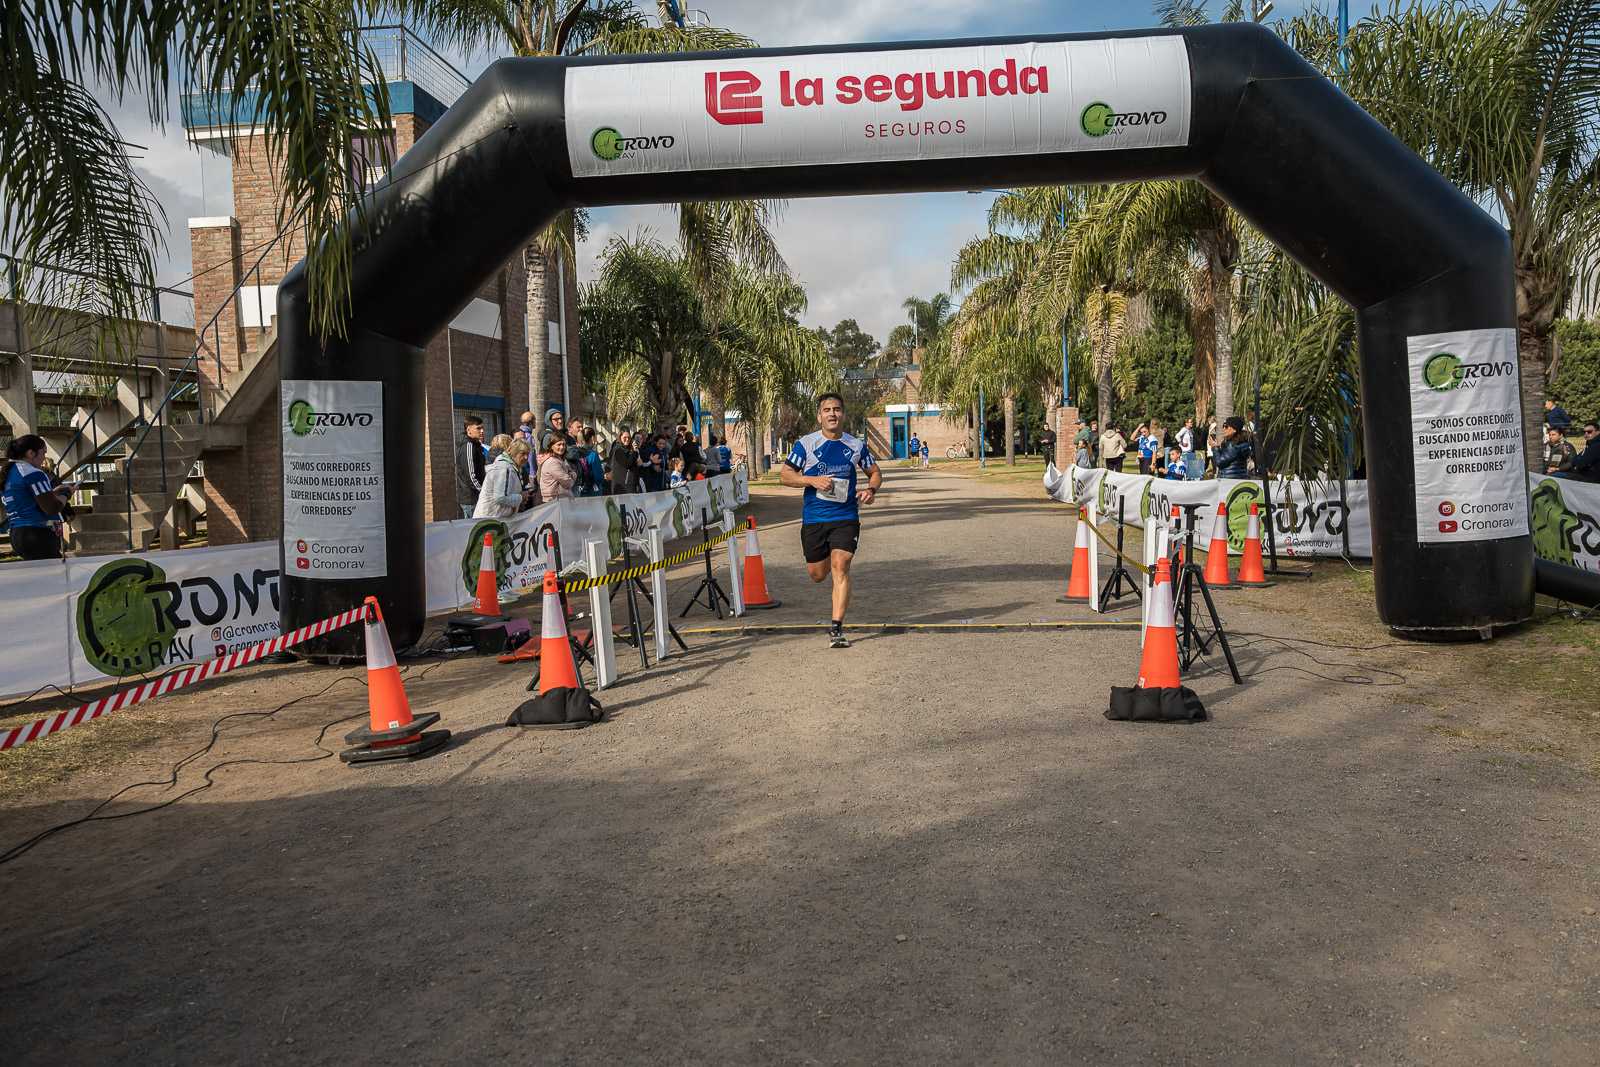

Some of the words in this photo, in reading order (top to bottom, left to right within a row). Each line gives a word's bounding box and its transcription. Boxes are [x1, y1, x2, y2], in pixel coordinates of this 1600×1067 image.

[780, 70, 824, 107] la
[835, 58, 1049, 112] segunda
[1104, 111, 1168, 127] CRONO
[864, 119, 966, 139] SEGUROS
[1102, 128, 1125, 136] RAV
[614, 135, 675, 151] CRONO
[614, 151, 636, 160] RAV
[1452, 361, 1514, 380] CRONO
[1451, 380, 1477, 390] RAV
[306, 412, 374, 427] CRONO
[1465, 413, 1514, 427] CORREDORES
[304, 428, 327, 436] RAV
[1419, 432, 1470, 445] BUSCANDO
[1472, 429, 1509, 442] MEJORAR
[1509, 428, 1520, 439] LAS
[1428, 446, 1493, 460] EXPERIENCIAS
[1494, 445, 1504, 455] DE
[1505, 443, 1516, 454] LOS
[316, 462, 371, 472] CORREDORES
[286, 474, 320, 486] BUSCANDO
[321, 476, 363, 487] MEJORAR
[363, 476, 379, 486] LAS
[291, 489, 341, 501] EXPERIENCIAS
[342, 491, 354, 501] DE
[355, 491, 372, 501] LOS
[1461, 502, 1514, 514] Cronorav
[1462, 518, 1514, 530] Cronorav
[311, 543, 365, 554] Cronorav
[312, 558, 365, 569] Cronorav
[148, 634, 194, 668] RAV
